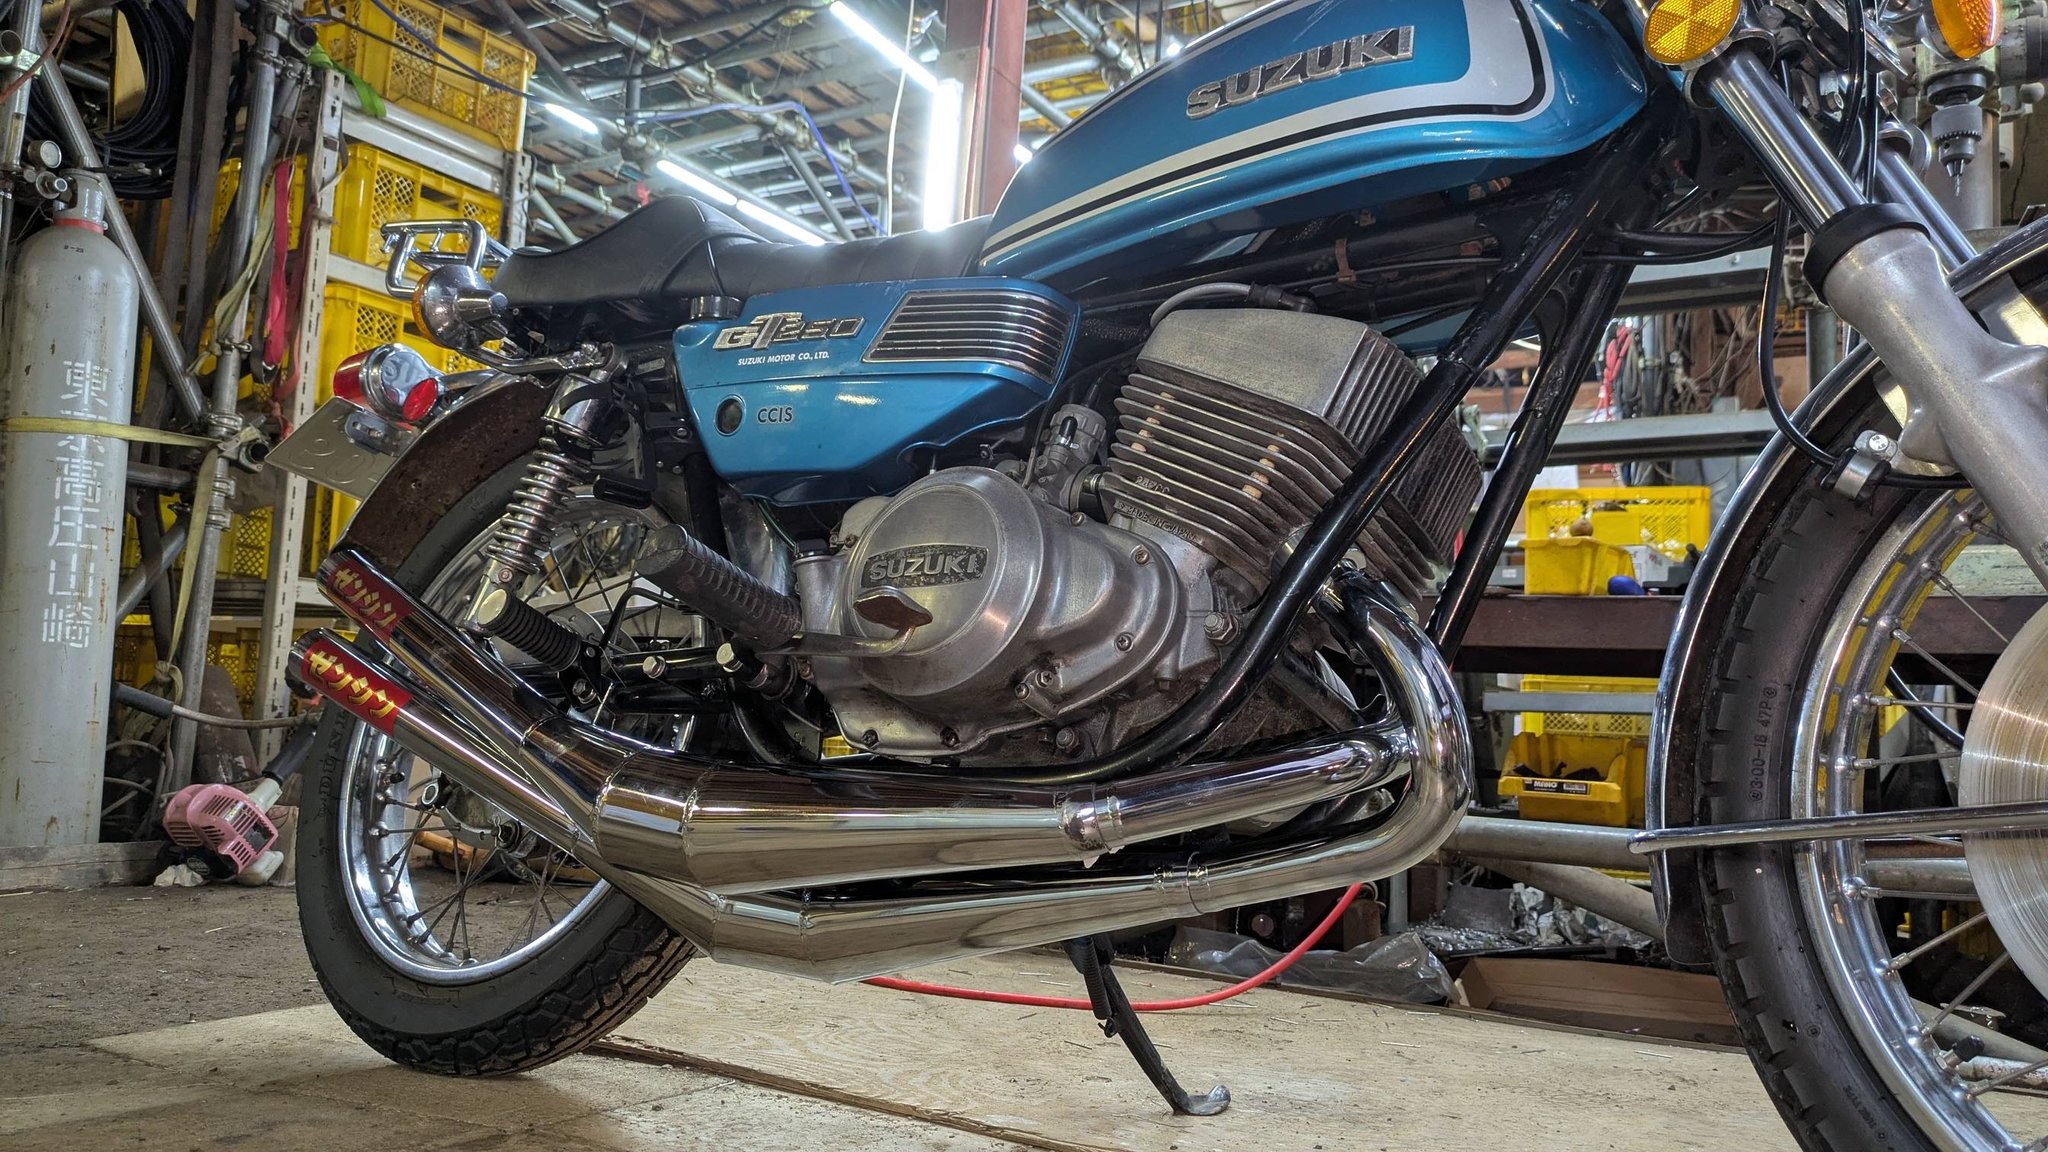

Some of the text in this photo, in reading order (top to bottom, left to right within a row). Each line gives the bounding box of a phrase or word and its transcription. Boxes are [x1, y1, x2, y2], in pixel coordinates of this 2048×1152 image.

[1186, 25, 1415, 119] SUZUKI
[737, 356, 766, 366] SUZUKI
[767, 353, 795, 363] MOTOR
[757, 407, 793, 423] CCIS
[1128, 507, 1148, 521] MADE
[869, 552, 977, 580] SUZUKI
[332, 568, 396, 627] ゼンシン
[308, 650, 396, 718] ゼンシン
